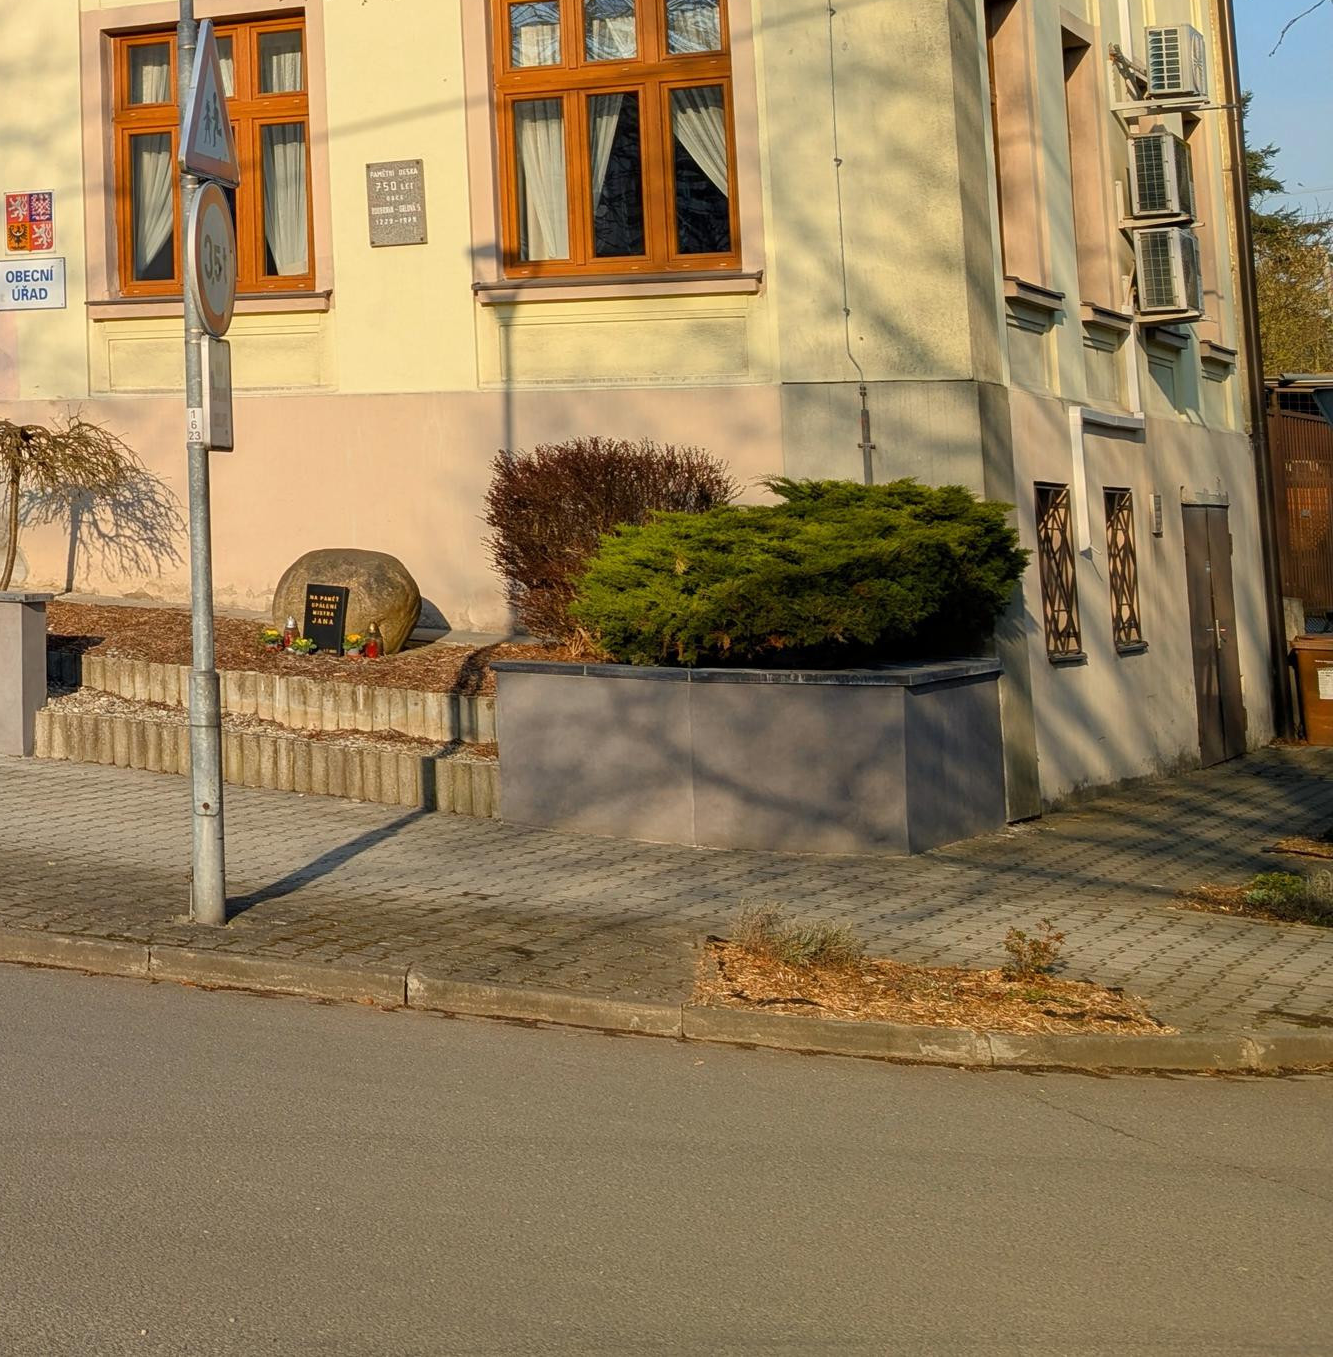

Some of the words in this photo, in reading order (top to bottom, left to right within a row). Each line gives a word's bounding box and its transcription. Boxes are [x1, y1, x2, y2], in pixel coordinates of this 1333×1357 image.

[375, 182, 397, 192] 750
[5, 265, 54, 283] OBECNÍ
[12, 285, 48, 301] ÚŘAD
[190, 420, 198, 430] 6
[188, 431, 201, 441] 23
[311, 617, 334, 625] JANA
